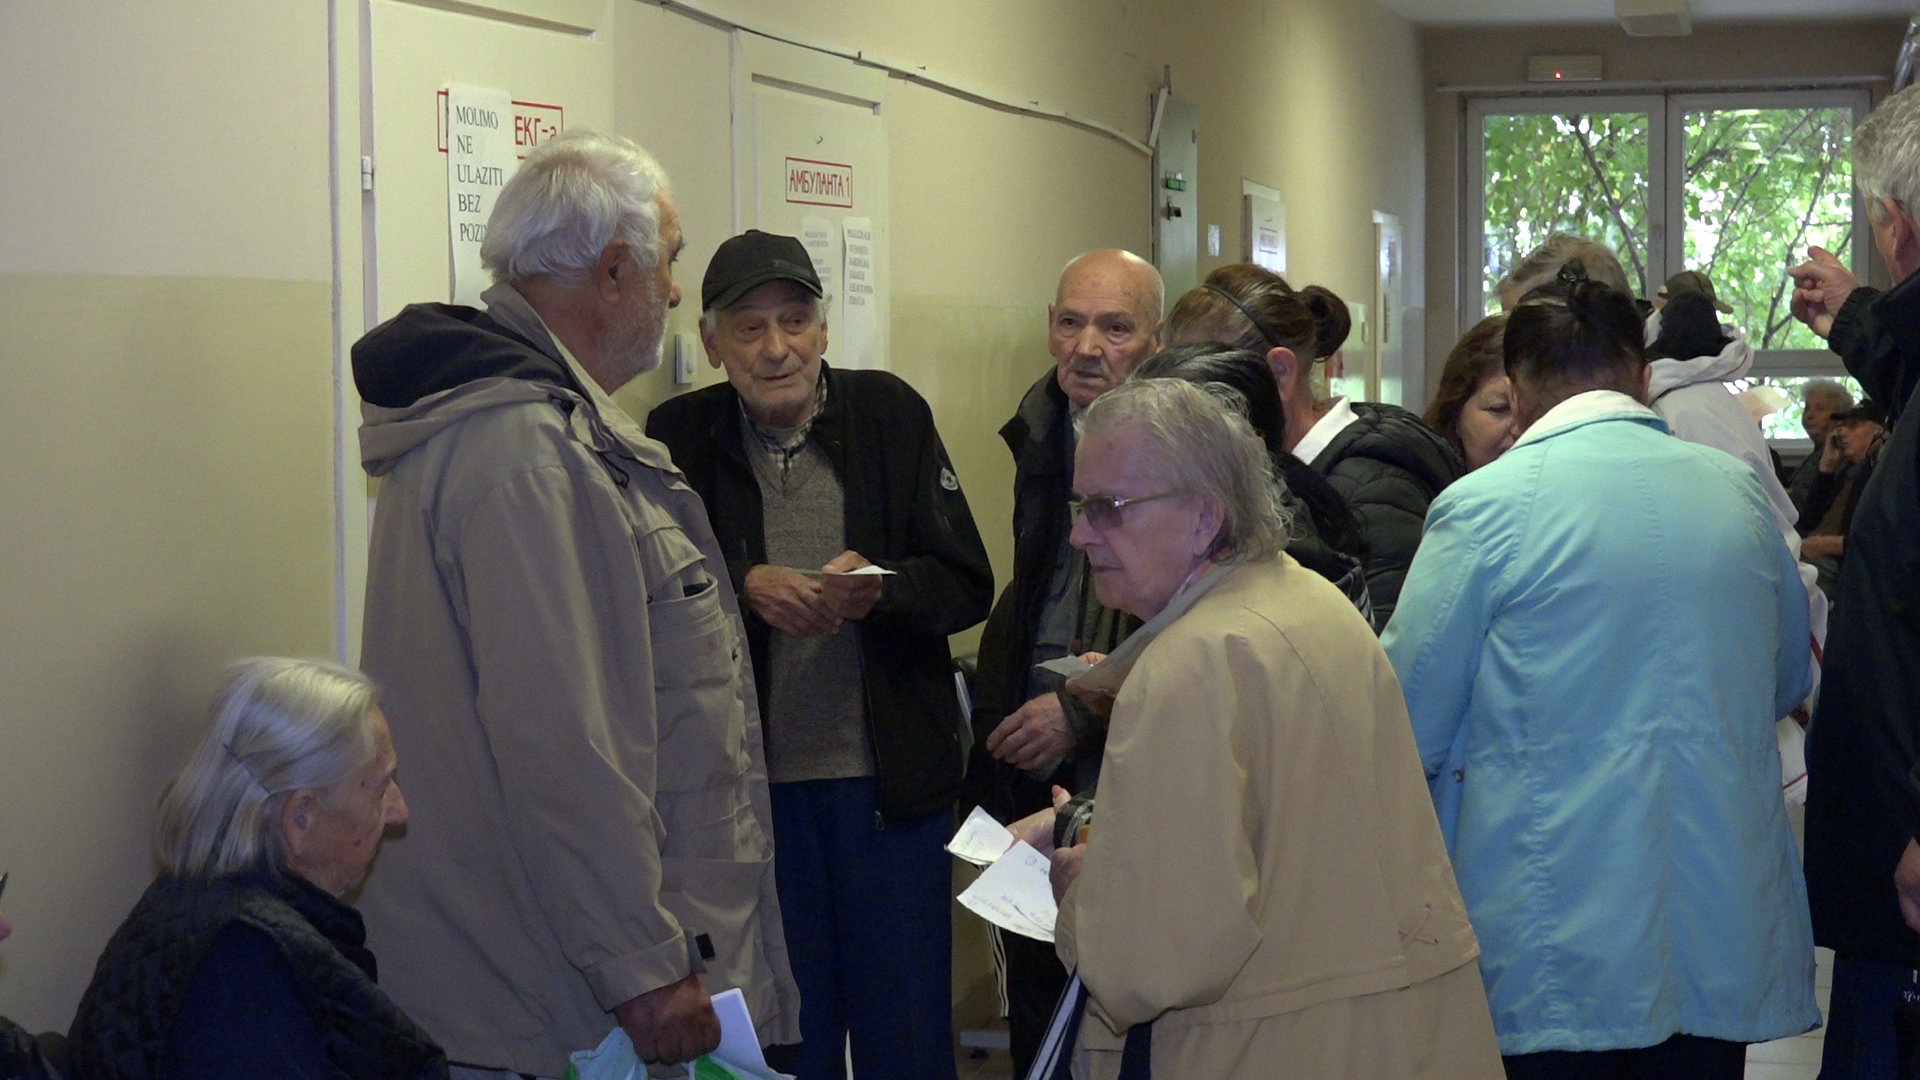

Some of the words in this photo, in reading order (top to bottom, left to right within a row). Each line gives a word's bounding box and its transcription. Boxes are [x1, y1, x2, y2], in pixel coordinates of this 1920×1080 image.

[456, 105, 499, 130] MOLIMO
[456, 134, 474, 154] NE
[457, 164, 503, 187] ULAZITI
[789, 169, 844, 197] АМБУЛАНТА
[846, 174, 850, 197] 1
[458, 193, 481, 213] BEZ
